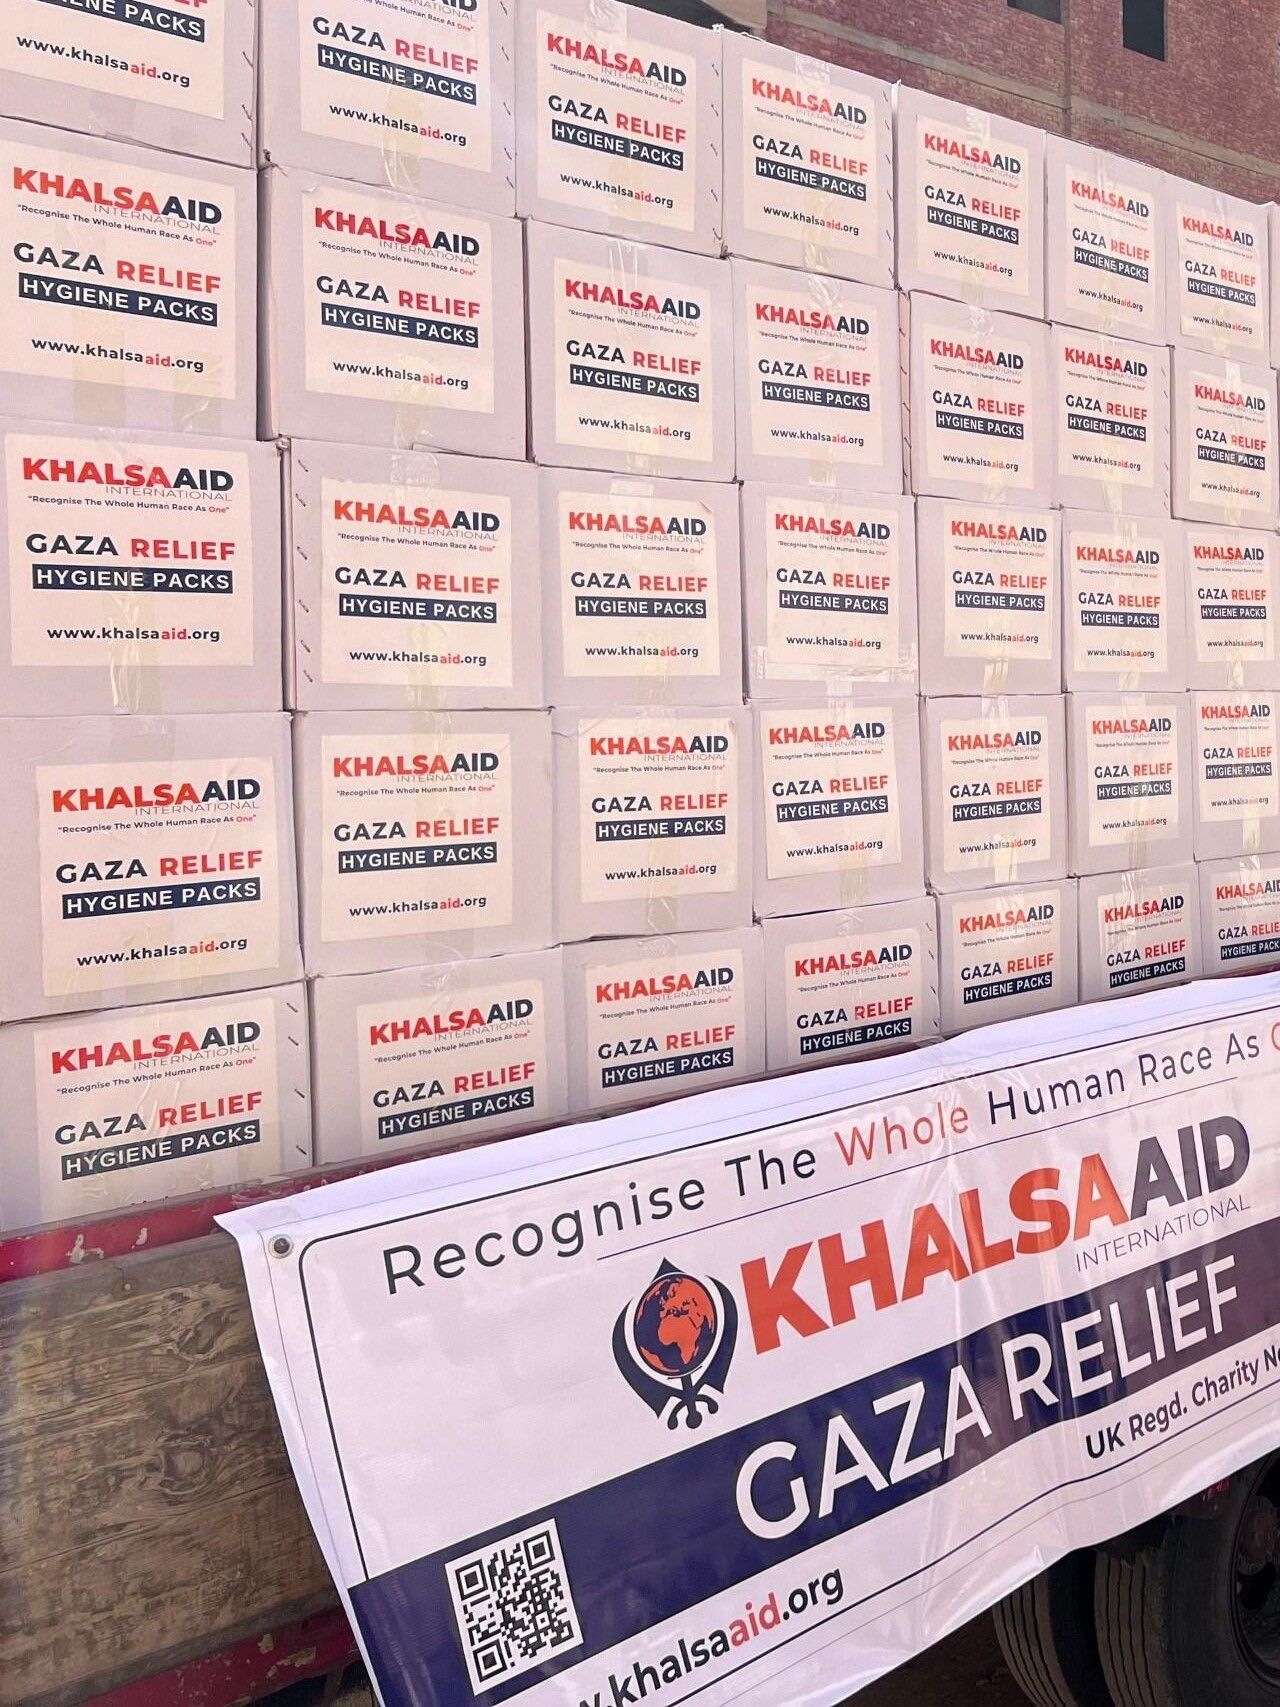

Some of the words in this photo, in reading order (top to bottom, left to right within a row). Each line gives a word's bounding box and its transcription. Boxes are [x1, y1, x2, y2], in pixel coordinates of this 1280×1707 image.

[124, 3, 200, 36] PACKS
[373, 0, 398, 11] Whole
[399, 5, 426, 19] Human
[427, 13, 445, 24] Race
[445, 19, 455, 27] As
[312, 16, 386, 51] GAZA
[395, 37, 478, 75] RELIEF
[16, 36, 190, 88] www.khalsaaid.org
[321, 48, 406, 83] HYGIENE
[412, 72, 474, 100] PACKS
[751, 77, 868, 125] KHALSAAID
[328, 104, 466, 147] www.khalsaaid.org
[554, 123, 625, 153] HYGIENE
[630, 142, 681, 167] PACKS
[12, 166, 222, 225] KHALSAAID
[924, 184, 967, 208] GAZA
[971, 197, 1021, 222] RELIEF
[72, 214, 90, 223] The
[91, 217, 122, 229] Whole
[124, 223, 157, 235] Human
[159, 229, 181, 240] Race
[182, 234, 194, 242] As
[92, 203, 221, 236] INTERNATIONAL
[762, 206, 859, 236] www.khalsaaid.org
[13, 242, 105, 275] GAZA
[117, 259, 222, 293] RELIEF
[1075, 249, 1116, 271] HYGIENE
[1118, 261, 1147, 280] PACKS
[23, 277, 129, 309] HYGIENE
[138, 296, 214, 322] PACKS
[564, 278, 701, 320] KHALSAAID
[325, 307, 409, 334] HYGIENE
[415, 321, 476, 344] PACKS
[31, 338, 203, 373] www.khalsaaid.org
[1064, 346, 1148, 377] KHALSAAID
[757, 358, 809, 379] GAZA
[813, 366, 871, 387] RELIEF
[578, 416, 690, 441] www.khalsaaid.org
[937, 413, 985, 431] HYGIENE
[987, 421, 1022, 437] PACKS
[1195, 426, 1227, 444] GAZA
[1230, 433, 1267, 451] RELIEF
[22, 457, 234, 492] KHALSAAID
[84, 498, 102, 506] The
[104, 499, 135, 508] Whole
[136, 501, 169, 509] Human
[171, 503, 193, 511] Race
[195, 504, 207, 512] As
[104, 484, 233, 503] INTERNATIONAL
[333, 499, 500, 532] KHALSAAID
[951, 519, 1047, 543] KHALSAAID
[25, 533, 119, 556] GAZA
[130, 538, 235, 561] RELIEF
[37, 568, 144, 587] HYGIENE
[153, 572, 229, 589] PACKS
[570, 571, 632, 589] GAZA
[638, 574, 708, 592] RELIEF
[781, 593, 840, 608] HYGIENE
[844, 597, 887, 611] PACKS
[1077, 591, 1115, 606] GAZA
[1118, 594, 1161, 608] RELIEF
[1201, 607, 1238, 617] HYGIENE
[1239, 607, 1266, 617] PACKS
[46, 626, 220, 643] www.khalsaaid.org
[348, 650, 486, 667] www.khalsaaid.org
[768, 722, 886, 745] KHALSAAID
[52, 779, 261, 813] KHALSAAID
[949, 782, 992, 799] GAZA
[995, 778, 1043, 795] RELIEF
[1098, 784, 1139, 798] HYGIENE
[1141, 782, 1171, 794] PACKS
[133, 799, 261, 819] INTERNATIONAL
[113, 822, 131, 830] The
[133, 820, 163, 829] Whole
[165, 819, 198, 827] Human
[333, 821, 407, 842] GAZA
[416, 816, 500, 838] RELIEF
[598, 822, 669, 838] HYGIENE
[674, 819, 724, 834] PACKS
[785, 840, 883, 858] www.khalsaaid.org
[55, 858, 148, 884] GAZA
[159, 849, 263, 876] RELIEF
[67, 889, 173, 914] HYGIENE
[181, 882, 257, 903] PACKS
[1103, 894, 1184, 924] KHALSAAID
[1217, 925, 1249, 941] GAZA
[76, 938, 247, 966] www.khalsaaid.org
[596, 967, 734, 1003] KHALSAAID
[648, 983, 734, 1005] INTERNATIONAL
[965, 981, 1013, 1001] HYGIENE
[1016, 974, 1051, 991] PACKS
[796, 1007, 849, 1030] GAZA
[854, 996, 913, 1020] RELIEF
[54, 1112, 147, 1145] GAZA
[158, 1090, 262, 1127] RELIEF
[382, 1104, 465, 1135] HYGIENE
[471, 1091, 531, 1116] PACKS
[383, 1178, 705, 1294] Recognise
[724, 1148, 817, 1197] The
[834, 1102, 969, 1167] Whole
[987, 1064, 1126, 1126] Human
[1139, 1042, 1213, 1088] Race
[1225, 1031, 1260, 1067] As
[740, 1115, 1251, 1355] KHALSAAID
[1075, 1195, 1251, 1272] INTERNATIONAL
[735, 1364, 993, 1540] GAZA
[1001, 1255, 1239, 1422] RELIEF
[1085, 1422, 1125, 1459] UK
[1128, 1391, 1188, 1441] Regd.
[1191, 1358, 1259, 1407] Charity
